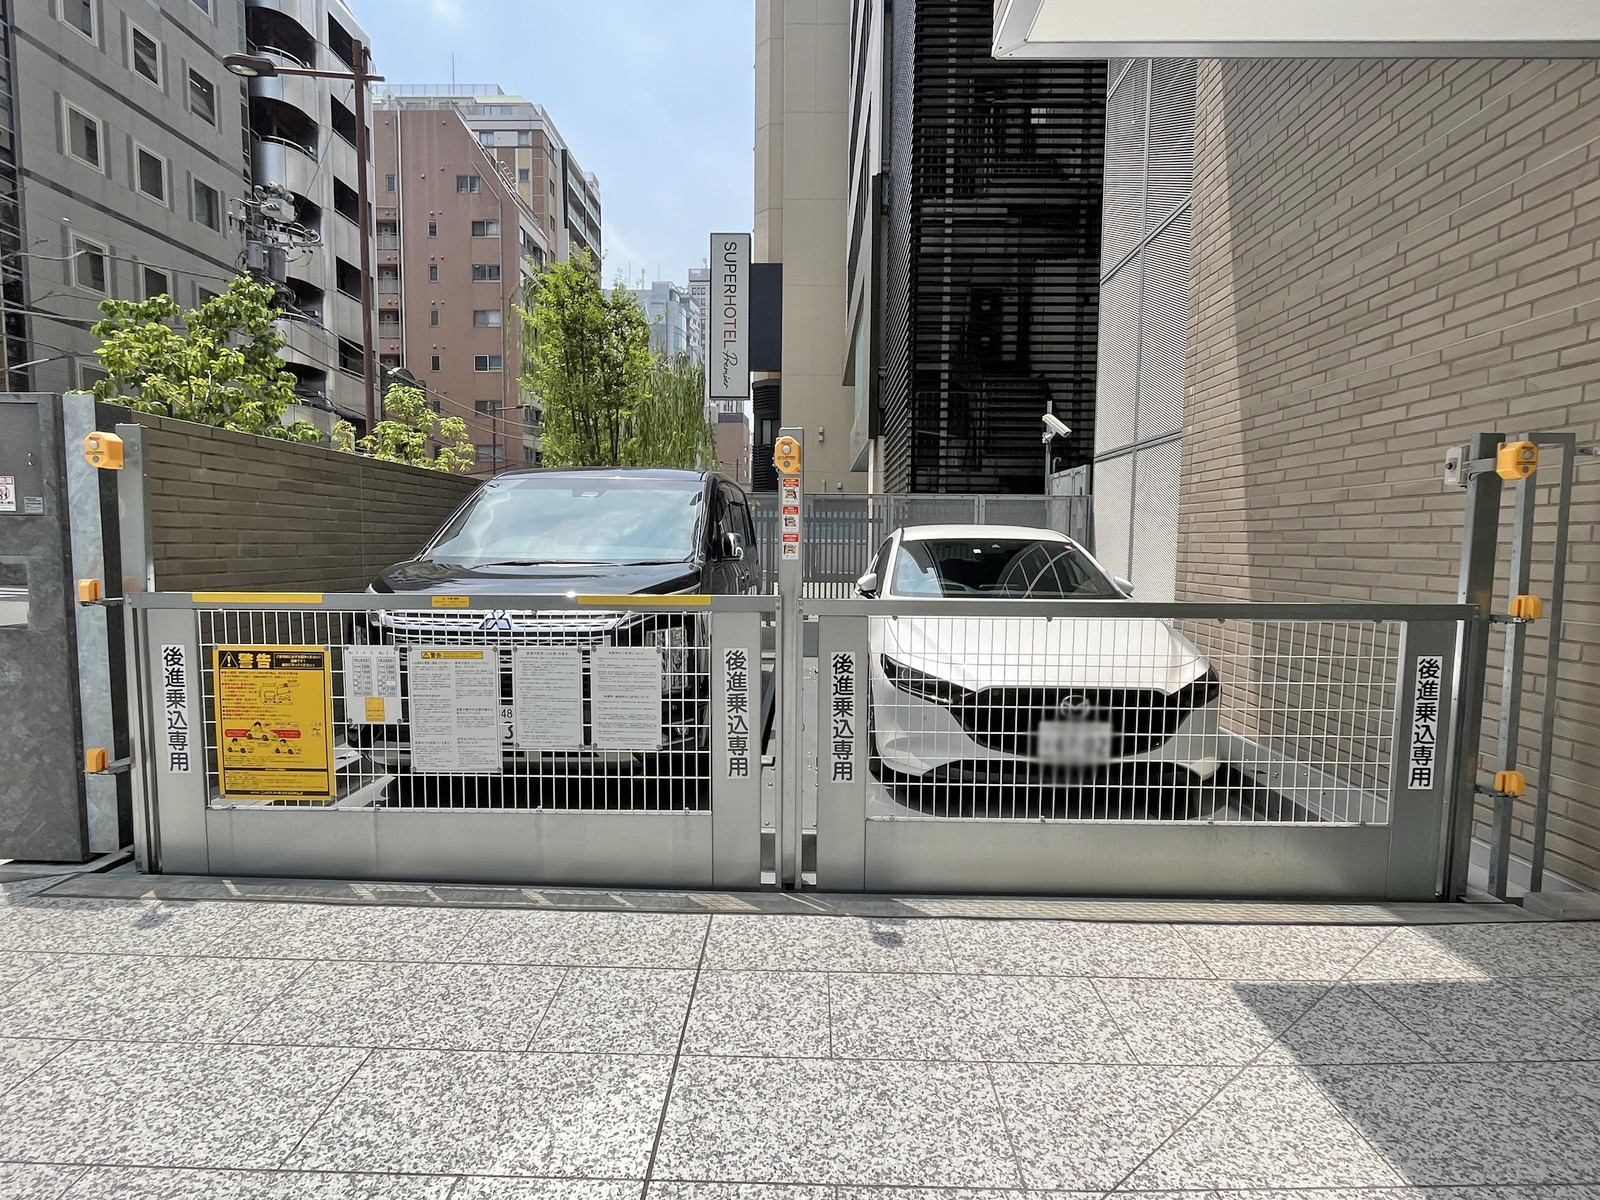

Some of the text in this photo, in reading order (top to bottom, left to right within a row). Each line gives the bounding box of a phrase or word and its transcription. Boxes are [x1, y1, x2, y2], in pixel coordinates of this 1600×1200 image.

[722, 241, 738, 390] SUPERHOTEL Premier
[163, 646, 189, 772] 後進乗込専用
[238, 653, 272, 669] 警告
[725, 650, 749, 777] 後進乗込専用
[832, 653, 854, 781] 後進乗込専用
[1410, 658, 1440, 787] 後進乗込専用
